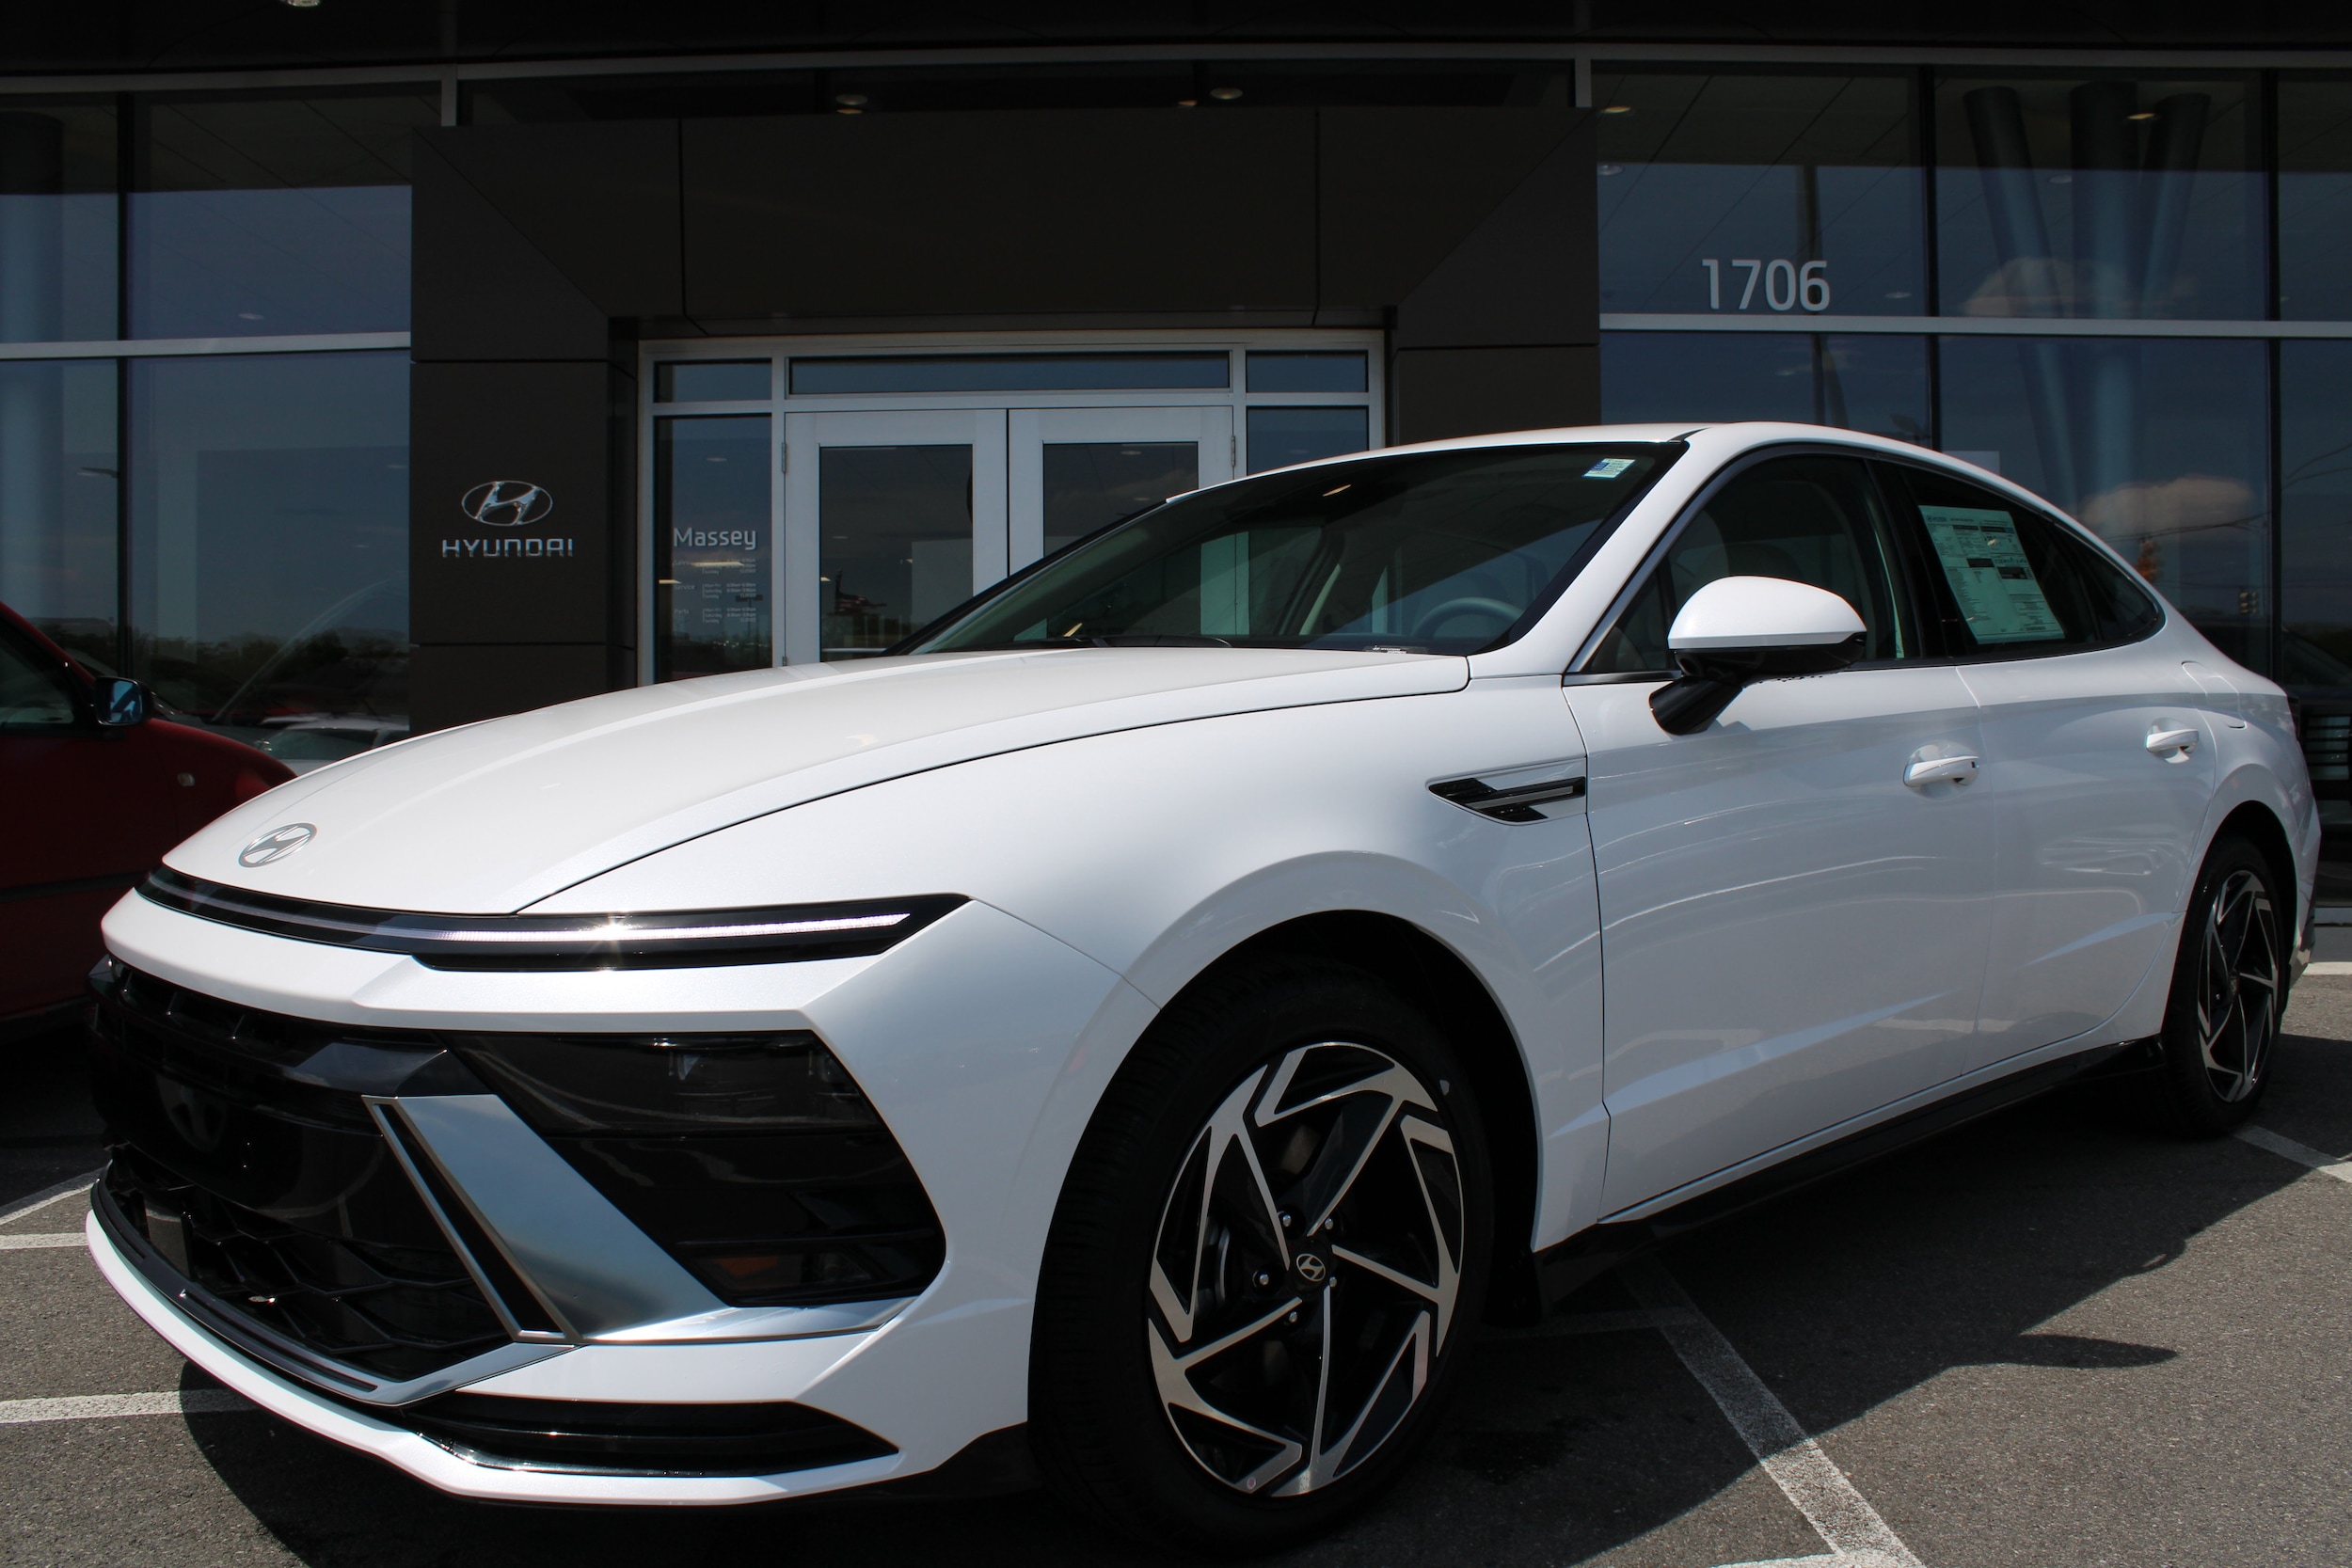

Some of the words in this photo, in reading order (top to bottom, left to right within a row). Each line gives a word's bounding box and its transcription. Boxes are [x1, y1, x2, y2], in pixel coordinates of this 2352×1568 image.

[1702, 259, 1830, 311] 1706
[442, 538, 574, 558] HYUNDAI
[674, 527, 756, 550] Massey
